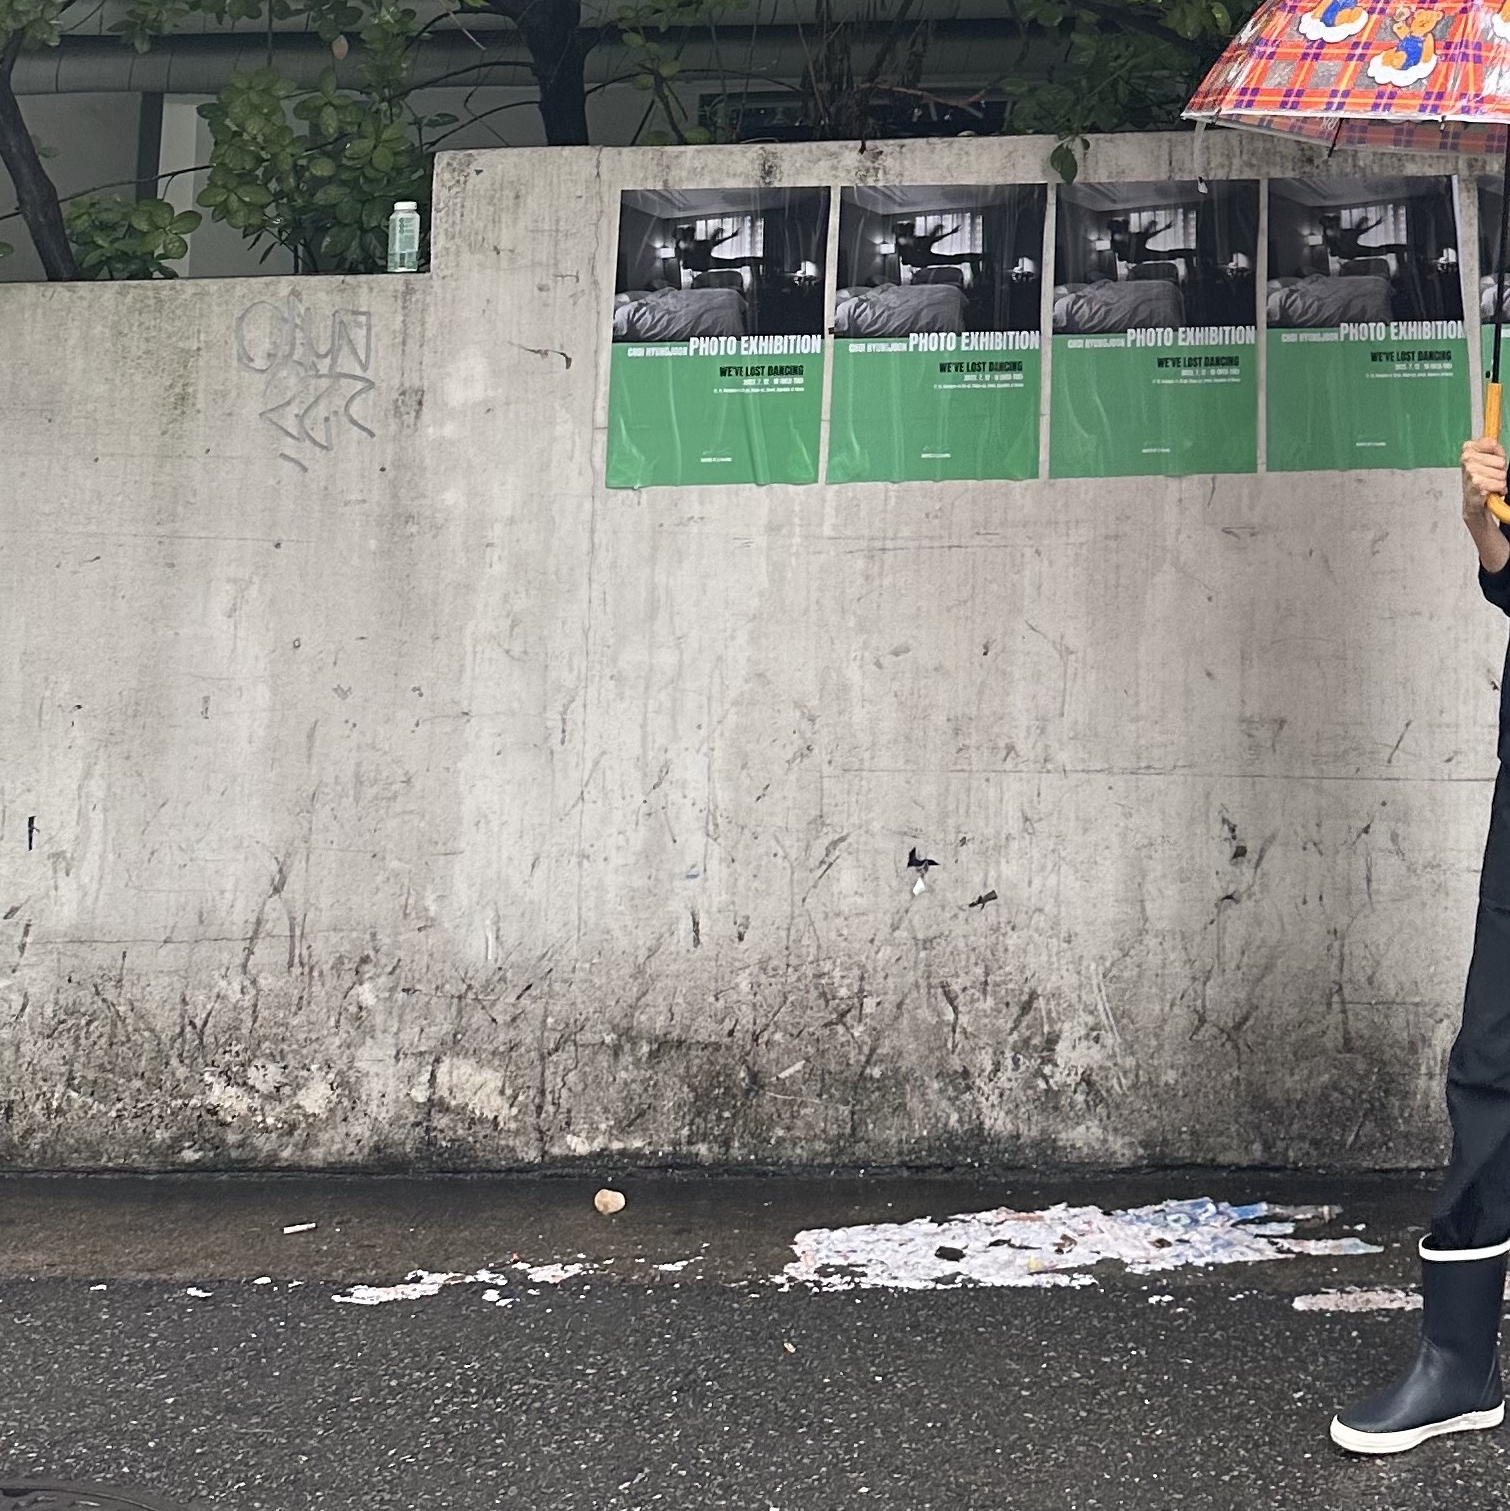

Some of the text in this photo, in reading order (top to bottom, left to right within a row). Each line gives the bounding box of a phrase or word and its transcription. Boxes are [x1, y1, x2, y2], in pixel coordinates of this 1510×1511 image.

[1126, 328, 1174, 348] PHOTO
[1177, 325, 1256, 346] EXHIBITION
[1339, 322, 1386, 342] PHOTO
[1390, 320, 1467, 341] EXHIBITION
[689, 336, 737, 357] PHOTO
[740, 334, 822, 356] EXHIBITION
[908, 332, 957, 352] PHOTO
[960, 330, 1040, 351] EXHIBITION
[1183, 356, 1203, 367] LOST
[1396, 351, 1416, 362] LOST
[745, 365, 765, 376] LOST
[966, 361, 986, 373] LOST
